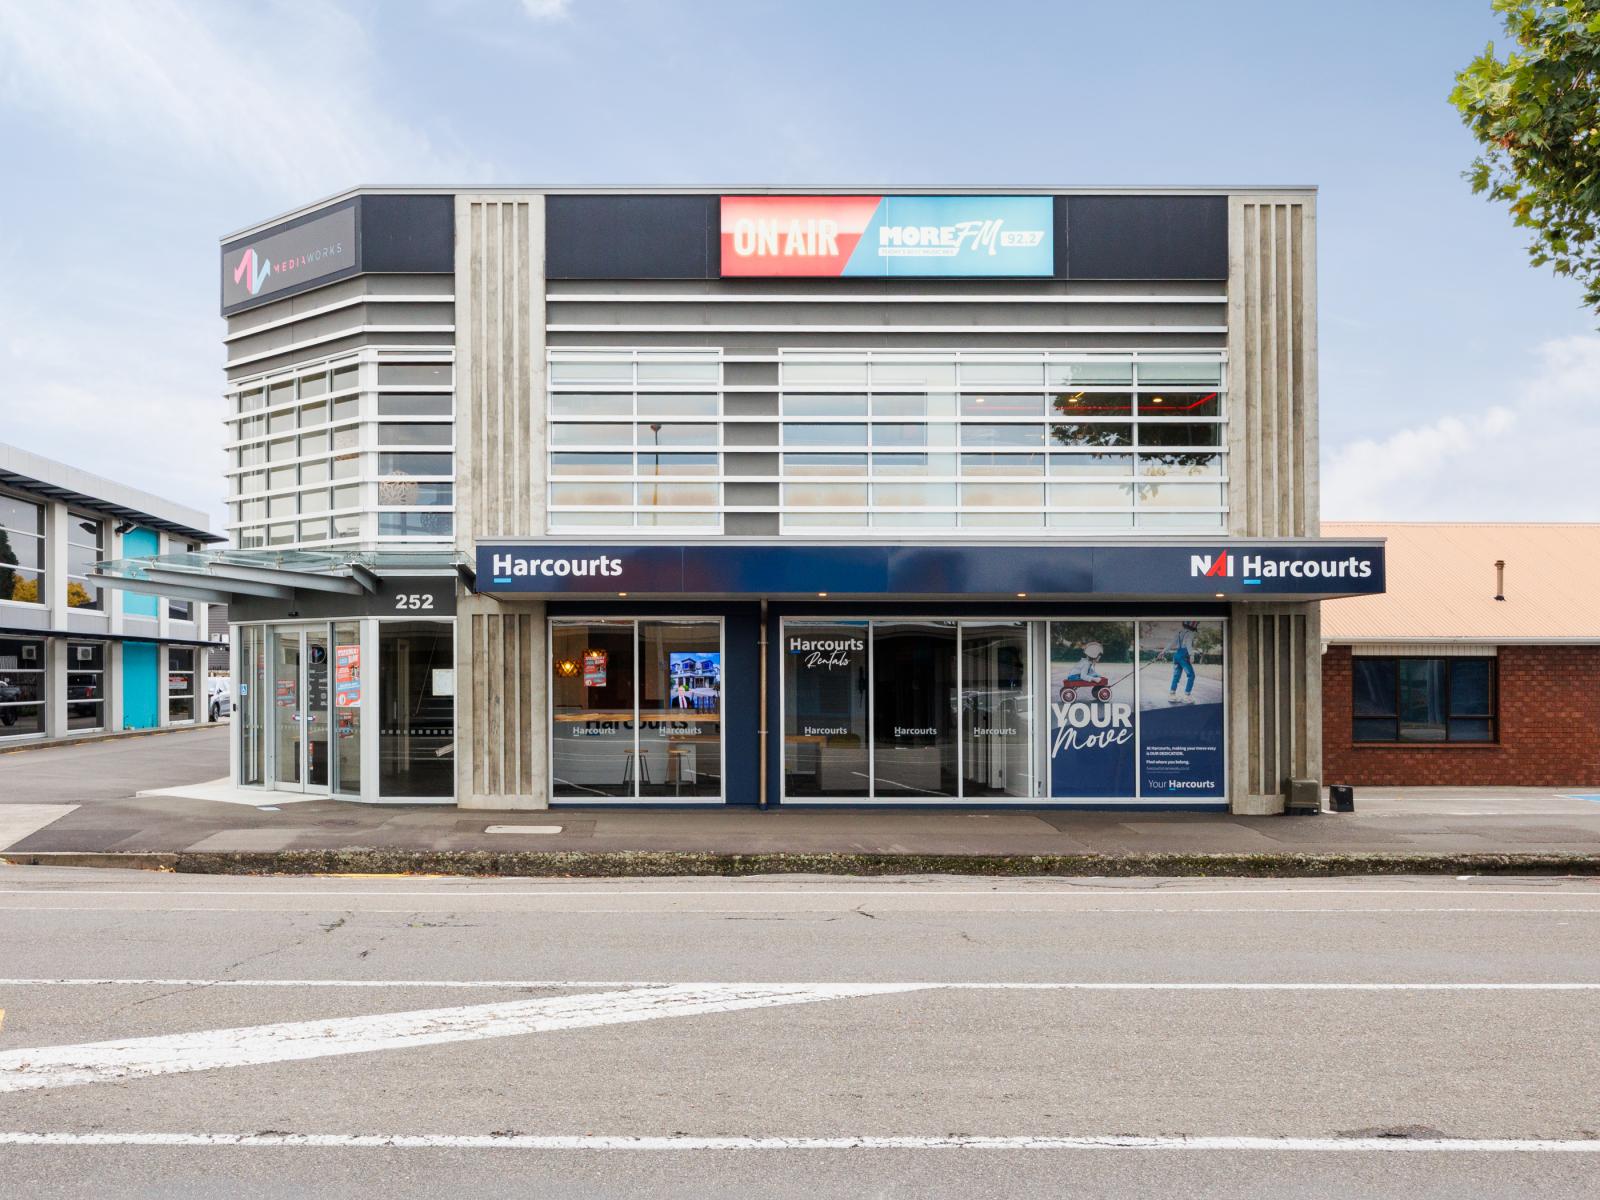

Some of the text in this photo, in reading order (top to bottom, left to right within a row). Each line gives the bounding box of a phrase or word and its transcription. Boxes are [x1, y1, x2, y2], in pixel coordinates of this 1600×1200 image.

[734, 218, 839, 256] ON AIR
[880, 219, 1037, 256] MORE FM 92.2
[273, 243, 342, 272] MEDIAWORKS
[493, 554, 623, 577] Harcourts
[1191, 550, 1372, 578] NAI Harcourts
[395, 594, 434, 609] 252
[790, 638, 864, 651] Harcourts
[804, 649, 850, 671] Rentals
[1052, 703, 1132, 728] YOUR
[573, 727, 616, 735] Harcourts
[659, 727, 702, 735] Harcourts
[804, 726, 847, 735] Harcourts
[894, 726, 937, 735] Harcourts
[973, 727, 1017, 735] Harcourts
[1052, 718, 1133, 759] Move
[1148, 780, 1215, 789] Your Harcourts
